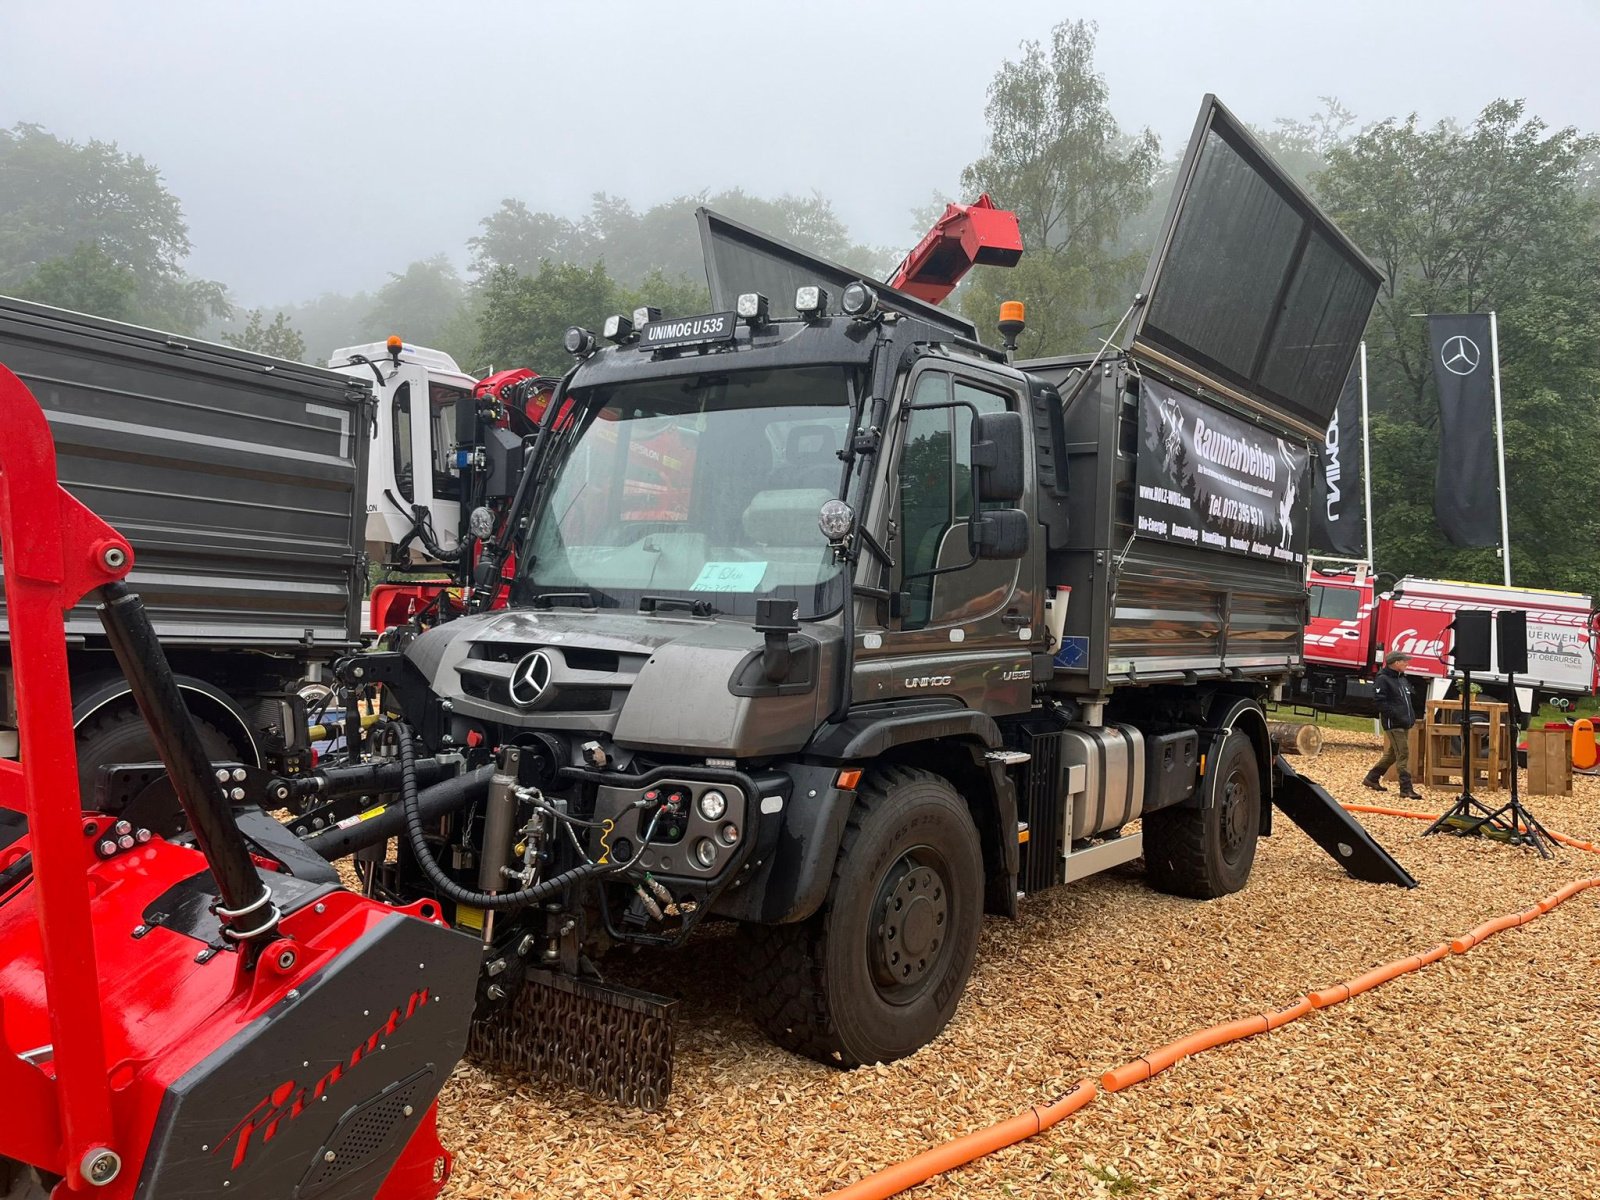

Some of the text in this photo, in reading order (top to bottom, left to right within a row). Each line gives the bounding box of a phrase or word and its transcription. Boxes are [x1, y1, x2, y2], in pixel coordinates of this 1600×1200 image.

[648, 317, 724, 341] UNIMOG U 535
[1193, 417, 1276, 483] Baumarbeiten
[1209, 494, 1221, 517] Tel.
[1222, 497, 1238, 520] 0172
[1528, 631, 1579, 643] UERWEH
[1401, 638, 1444, 657] 112
[1538, 653, 1582, 665] OBERURSEL
[905, 675, 952, 689] UNIMOG
